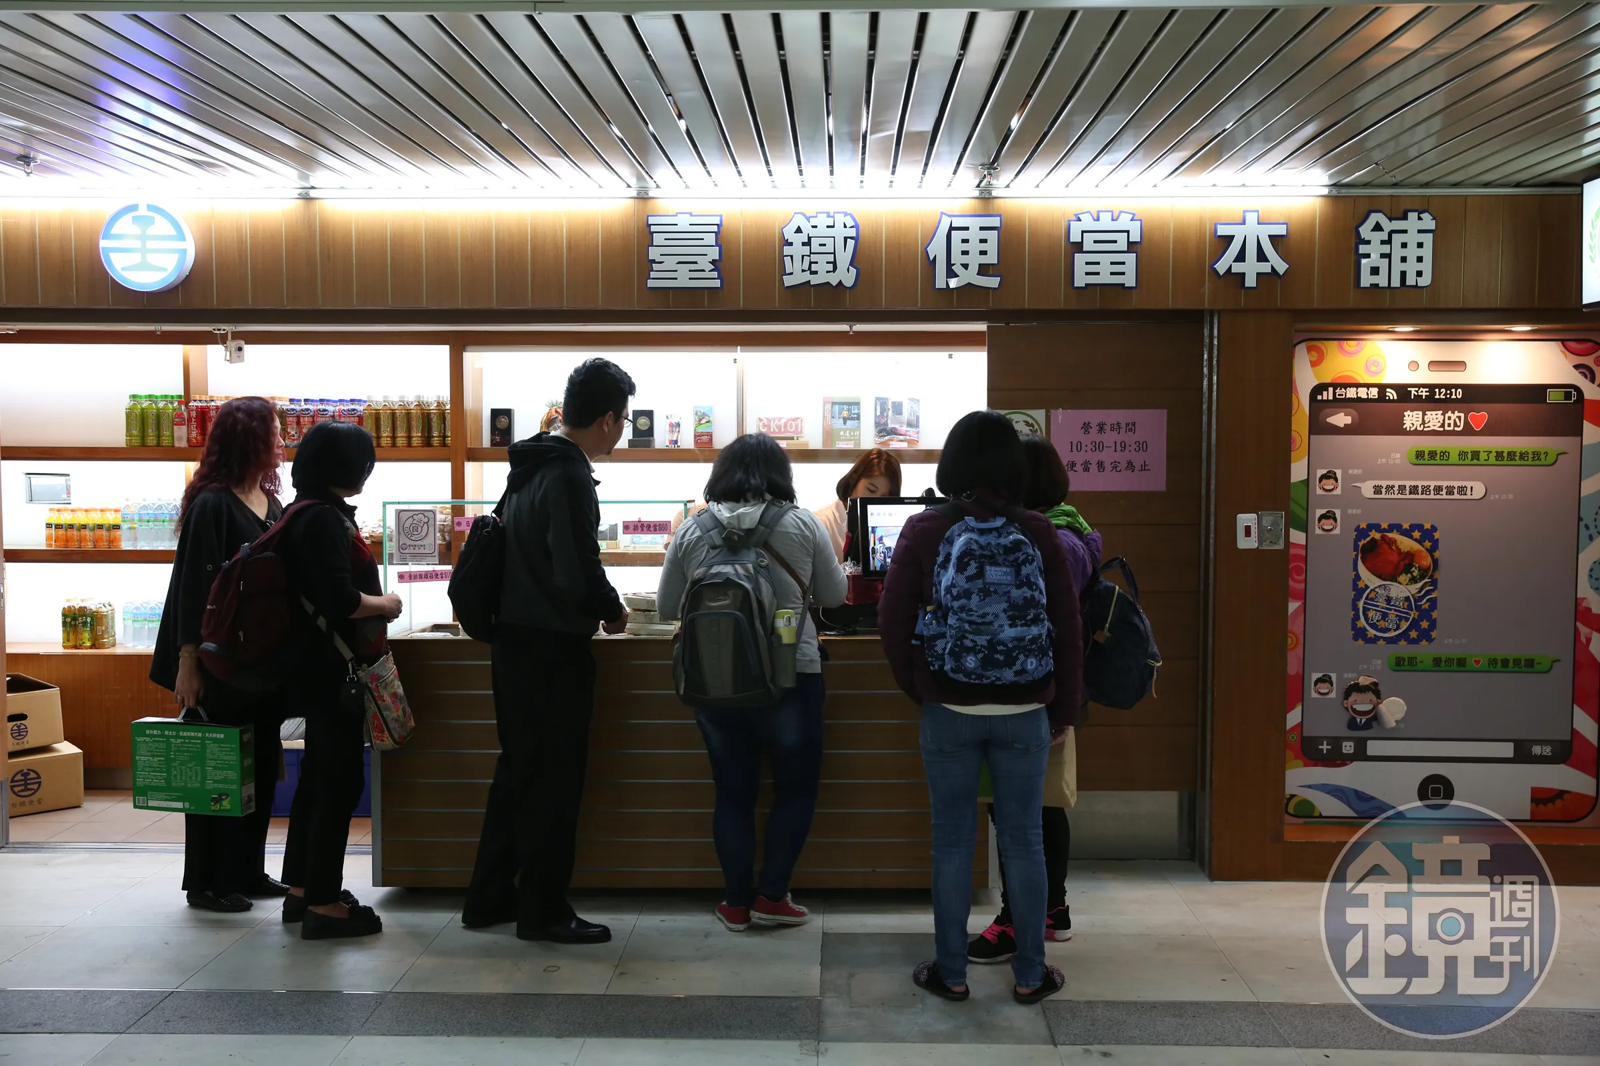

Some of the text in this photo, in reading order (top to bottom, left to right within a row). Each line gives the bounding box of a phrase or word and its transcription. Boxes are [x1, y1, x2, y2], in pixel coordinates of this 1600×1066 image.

[1336, 387, 1462, 399] 台鐵電信 下午 12:10
[759, 417, 802, 433] CK101
[1403, 410, 1464, 431] 親愛的
[1080, 421, 1137, 435] 營業時間
[1068, 440, 1149, 453] 10:30-19:30
[1415, 450, 1450, 462] 親愛的
[1065, 459, 1151, 473] 便當售完為止
[1372, 484, 1475, 496] 當然是鐵路便當啦!
[966, 656, 976, 667] S
[1027, 658, 1036, 668] D
[1531, 745, 1552, 756] 傳送
